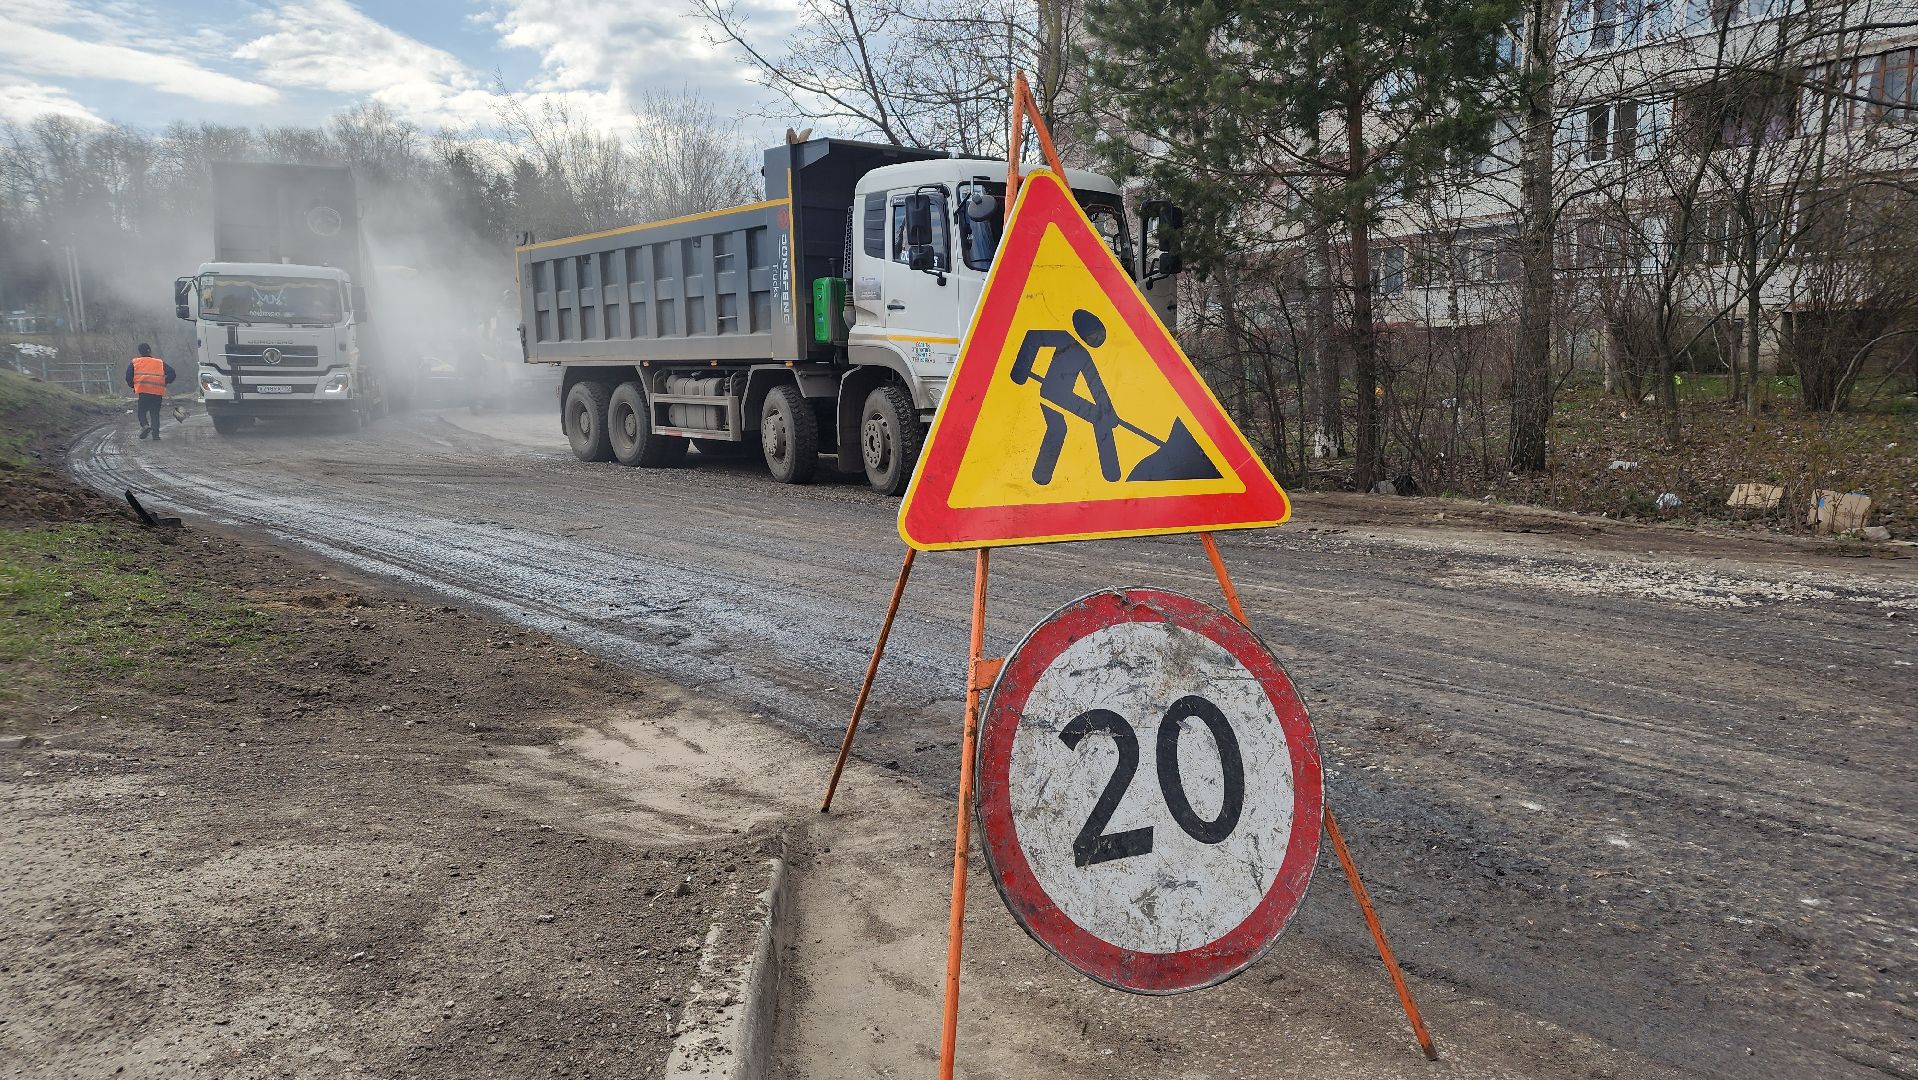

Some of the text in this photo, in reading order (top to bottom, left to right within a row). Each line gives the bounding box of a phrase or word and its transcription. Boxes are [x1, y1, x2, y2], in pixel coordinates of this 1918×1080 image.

[772, 262, 780, 298] Trucks
[781, 233, 790, 325] DONGFENG
[1058, 695, 1245, 868] 20
